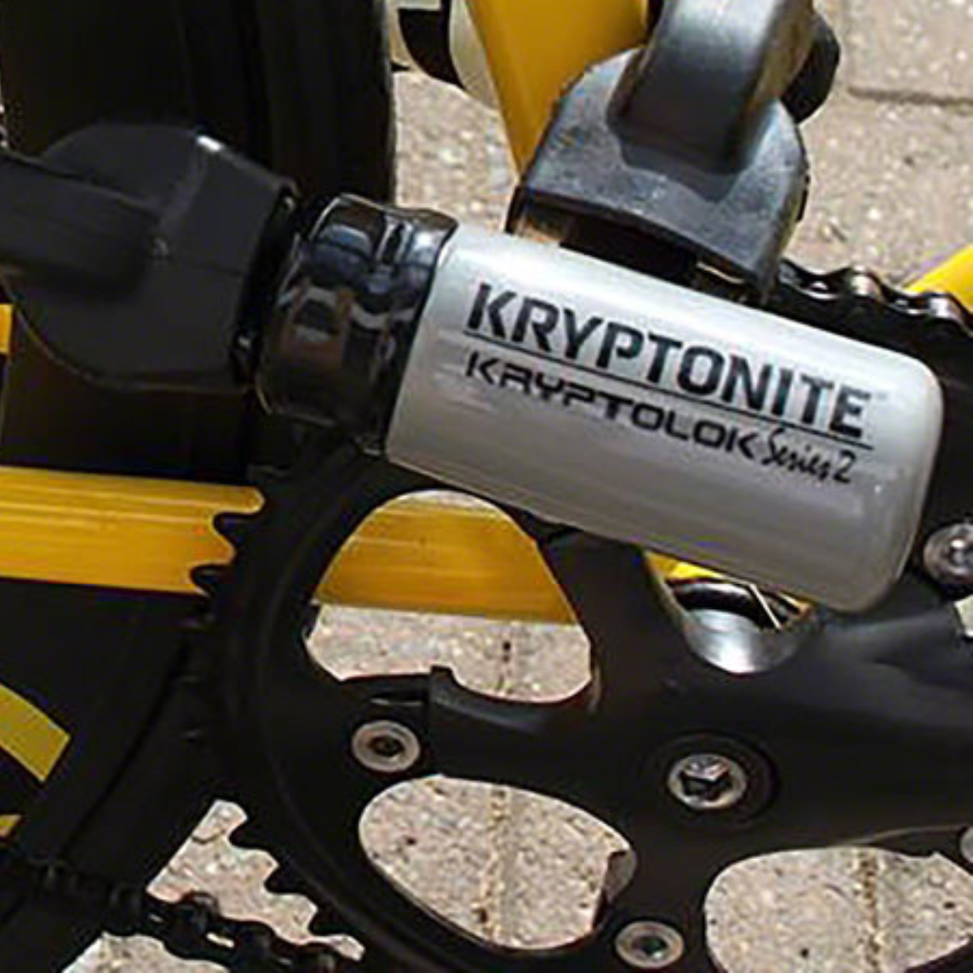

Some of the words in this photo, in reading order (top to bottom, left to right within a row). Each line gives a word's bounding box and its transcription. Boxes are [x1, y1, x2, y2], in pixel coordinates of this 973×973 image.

[465, 351, 759, 459] KRYPTOLOK
[761, 428, 832, 482] Series
[832, 449, 857, 484] 2
[467, 282, 871, 438] KRYPTONITE
